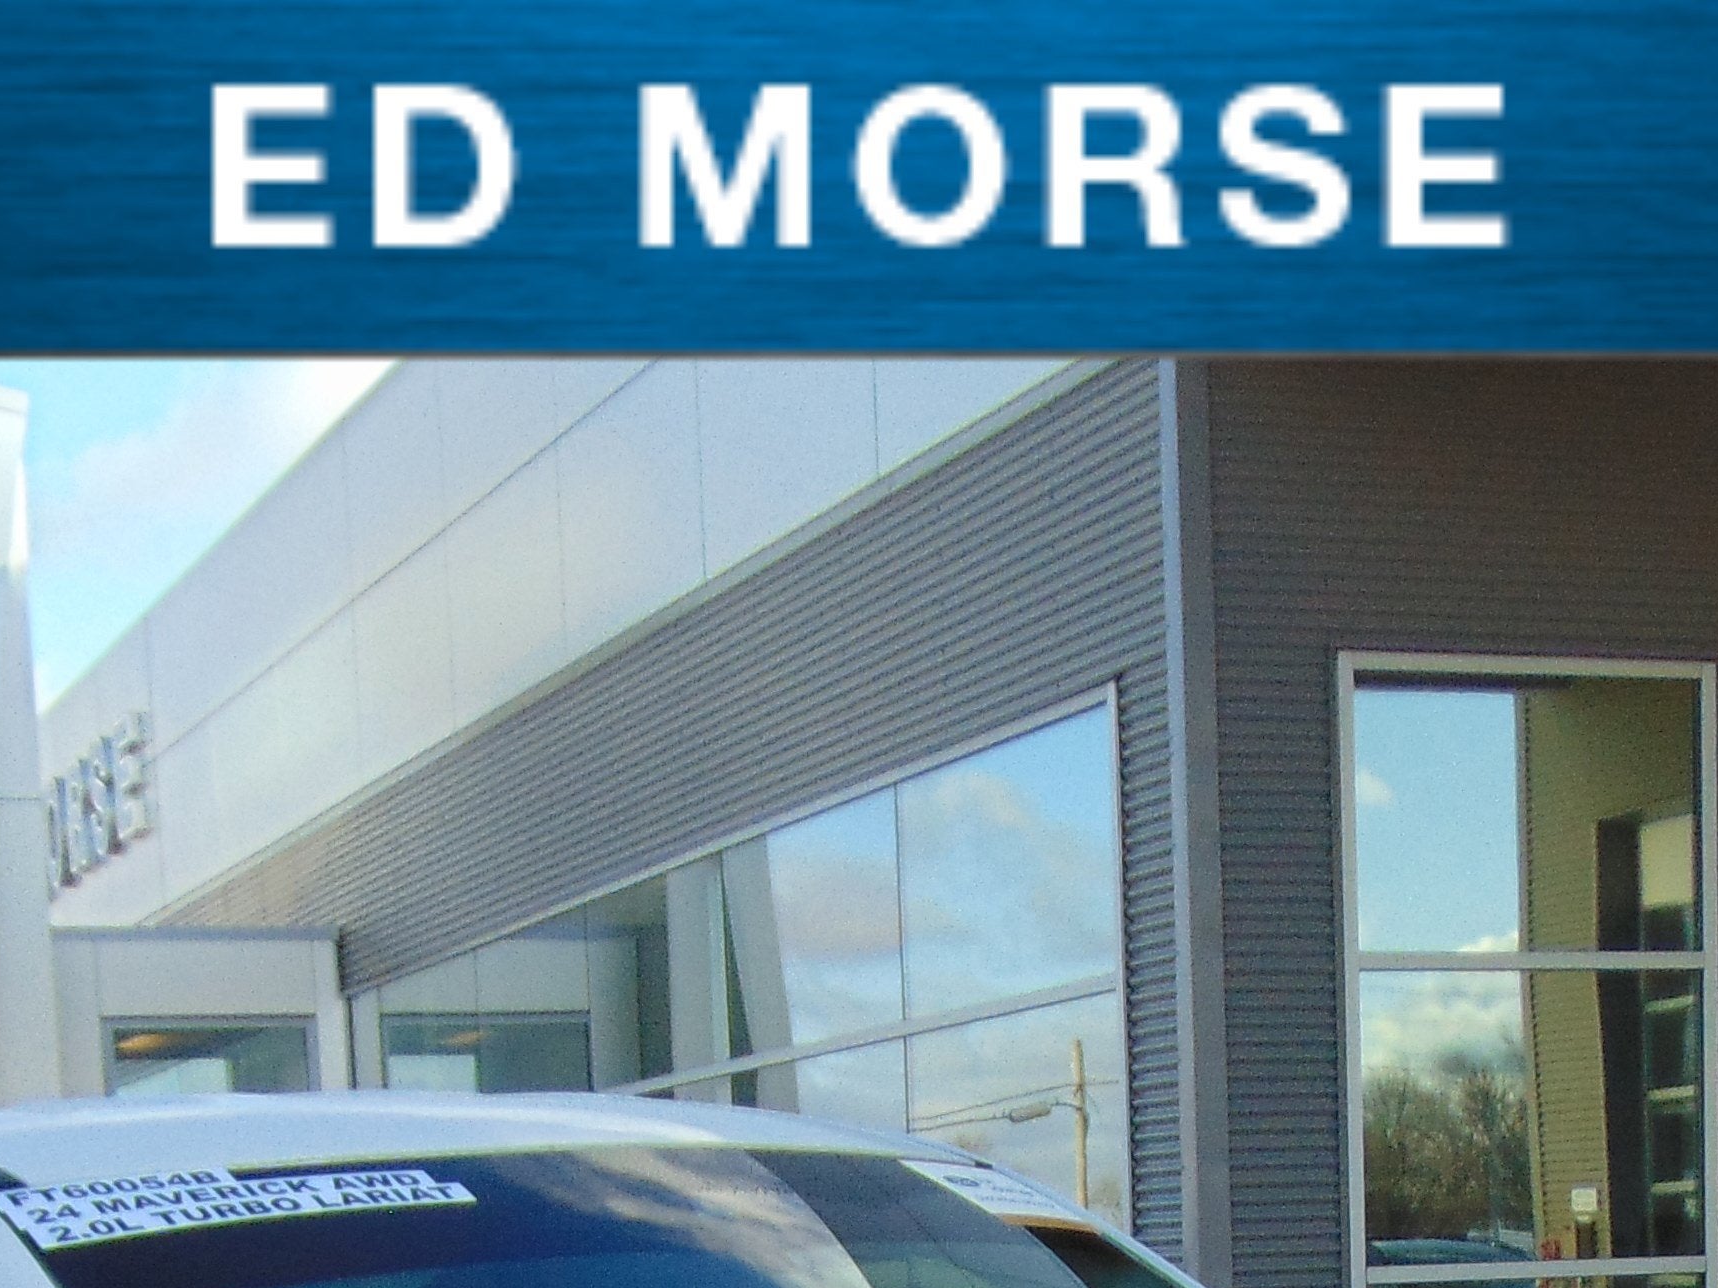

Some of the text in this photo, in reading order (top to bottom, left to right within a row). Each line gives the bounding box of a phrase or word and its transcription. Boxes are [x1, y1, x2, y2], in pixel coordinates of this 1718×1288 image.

[5, 1168, 221, 1207] FT60054B
[26, 1170, 422, 1225] 24 MAVERICK AWD
[48, 1181, 457, 1243] 2.0L TURBO LARIAT
